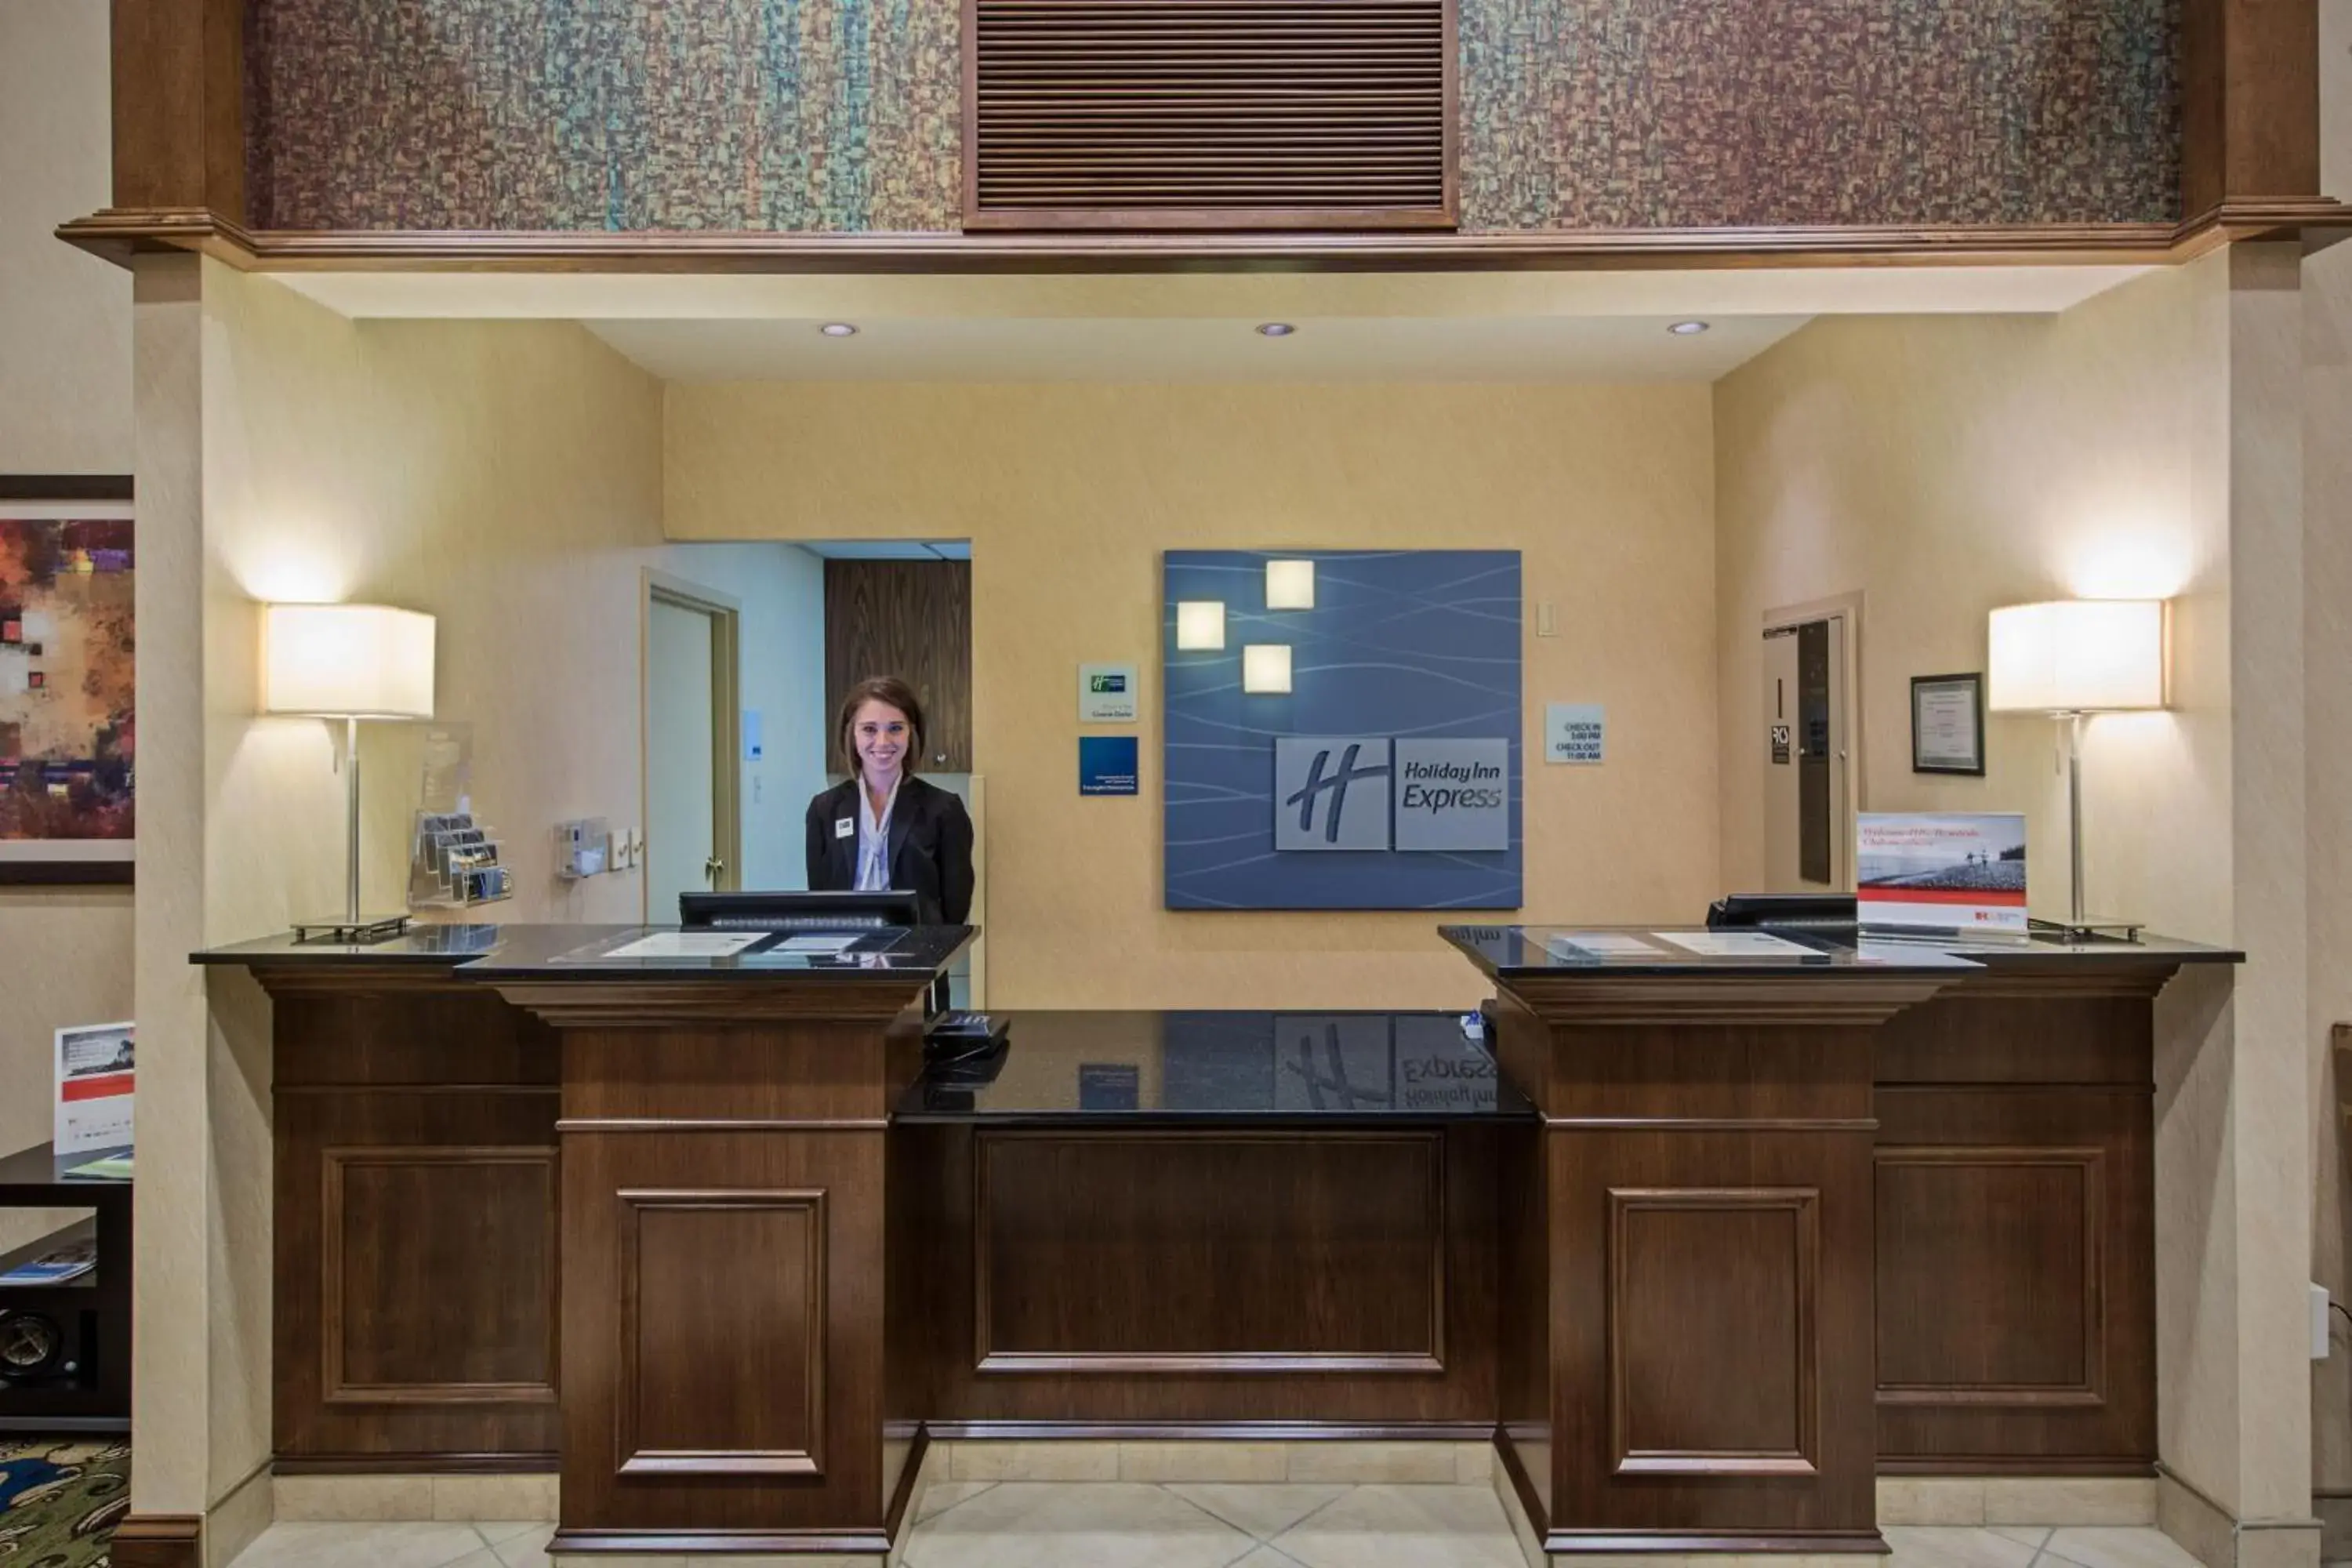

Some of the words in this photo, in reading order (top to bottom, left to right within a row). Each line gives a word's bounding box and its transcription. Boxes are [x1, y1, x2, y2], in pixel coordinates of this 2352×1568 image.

[1564, 722, 1592, 731] CHECK
[1555, 742, 1582, 751] CHECK
[1583, 742, 1600, 751] OUT
[1405, 762, 1471, 782] Holiday
[1472, 762, 1500, 779] Inn
[1403, 784, 1501, 814] Express
